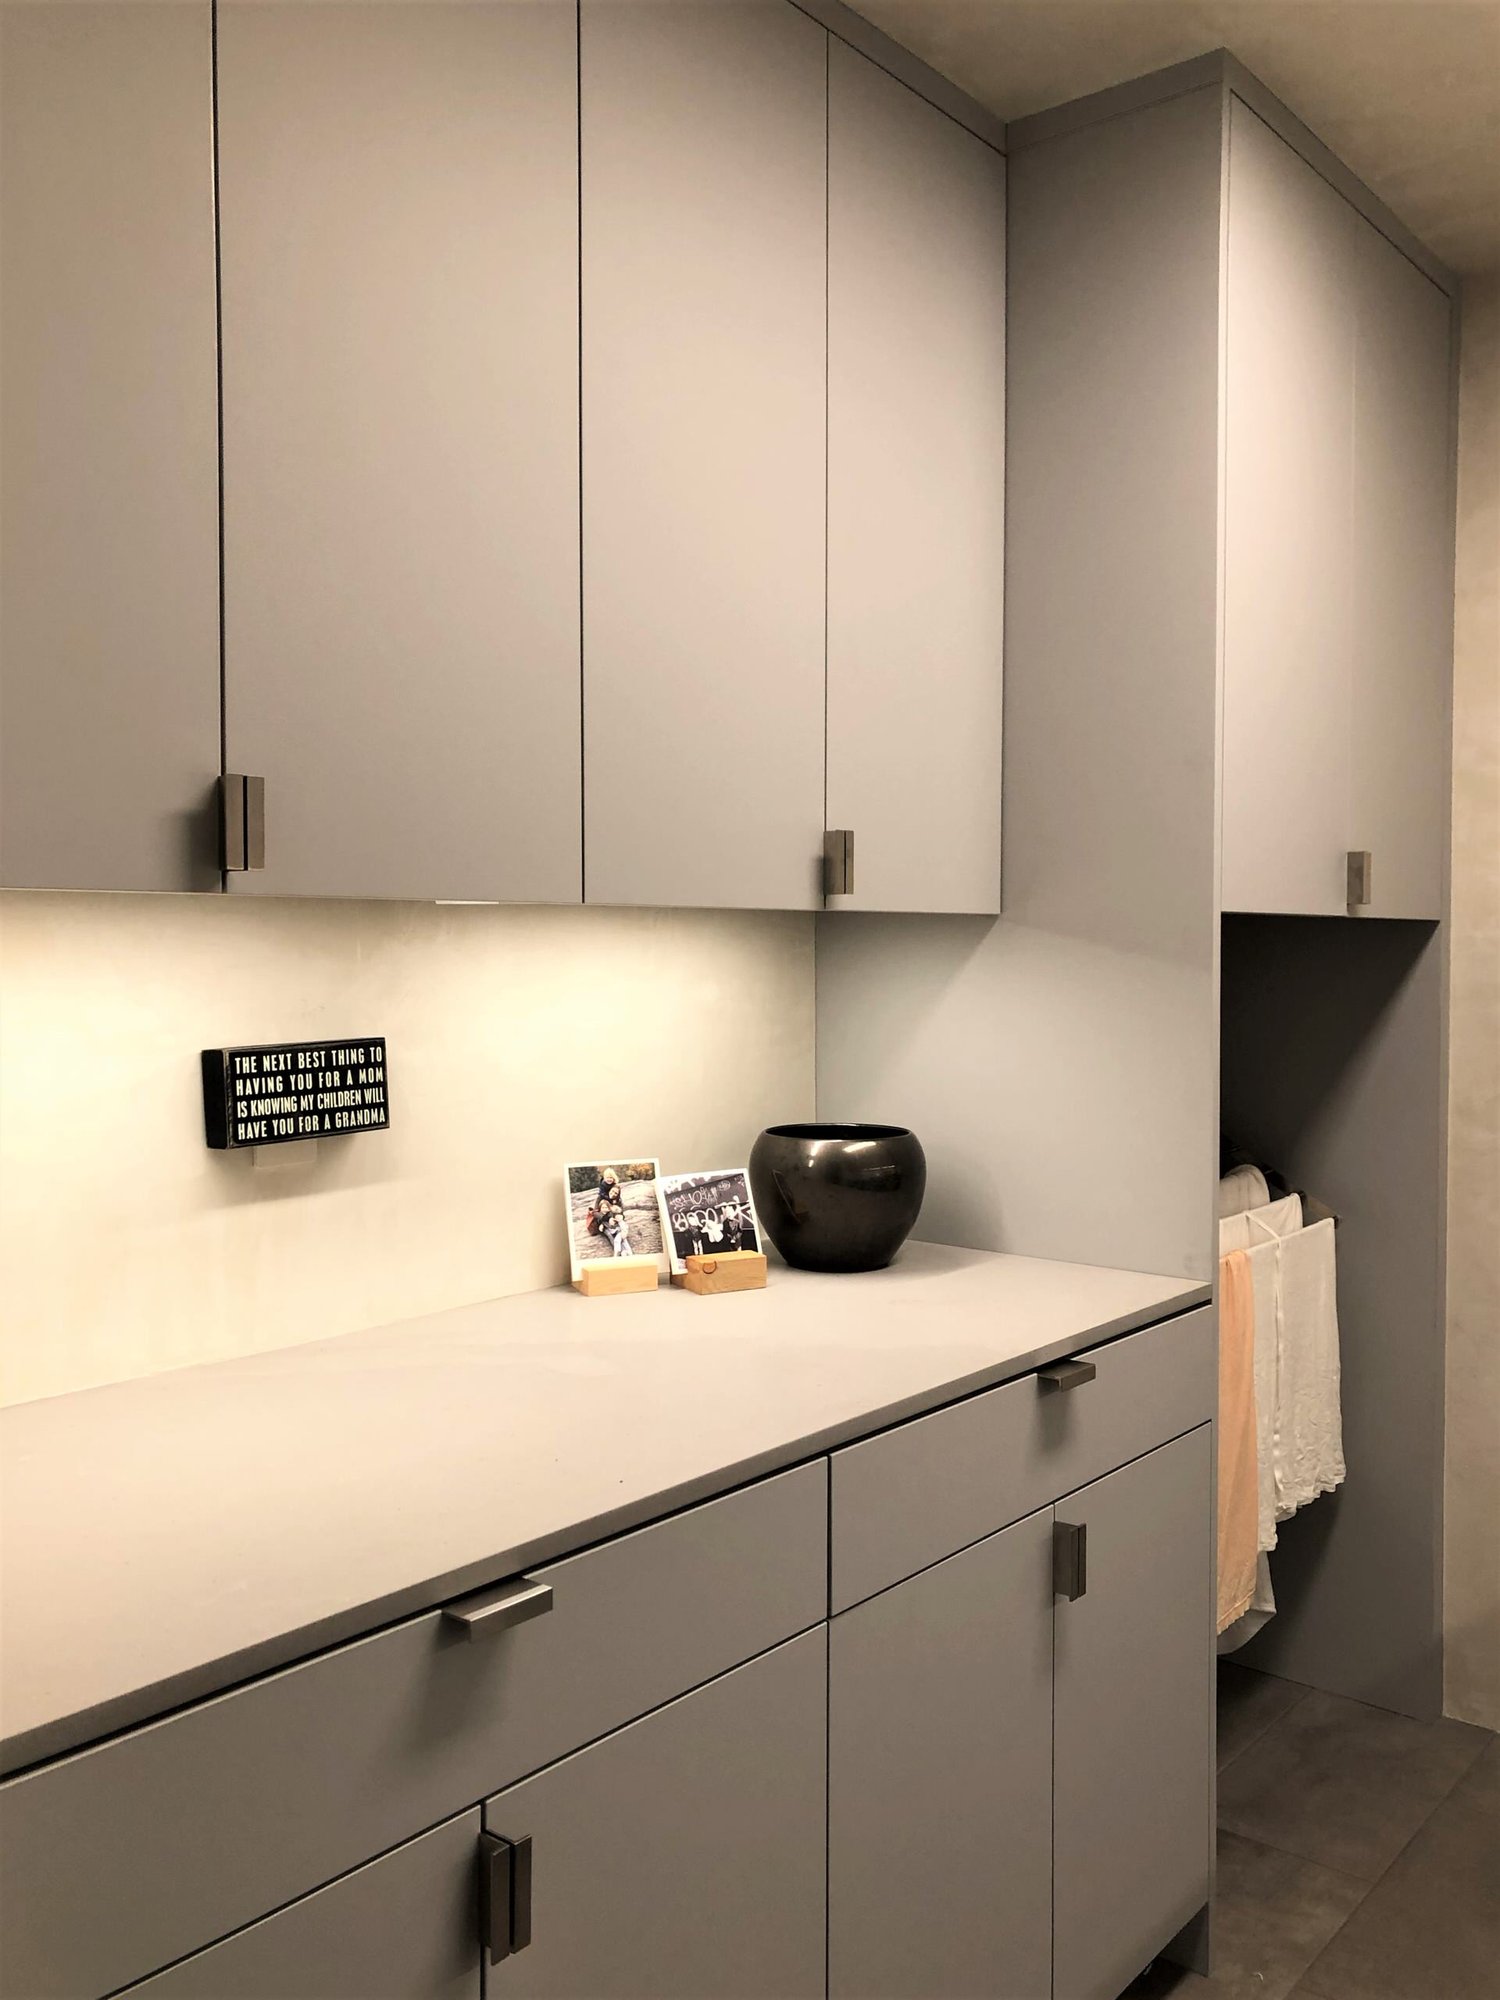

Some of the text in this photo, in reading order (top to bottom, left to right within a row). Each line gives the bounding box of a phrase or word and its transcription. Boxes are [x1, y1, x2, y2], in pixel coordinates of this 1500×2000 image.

[235, 1047, 382, 1074] THE NEXT BEST THING TO
[236, 1067, 383, 1096] HAVING YOU FOR A MOM
[237, 1087, 384, 1118] IS KNOWING MY CHILDREN WILL
[238, 1107, 385, 1140] HAVE YOU FOR A GRANDMA
